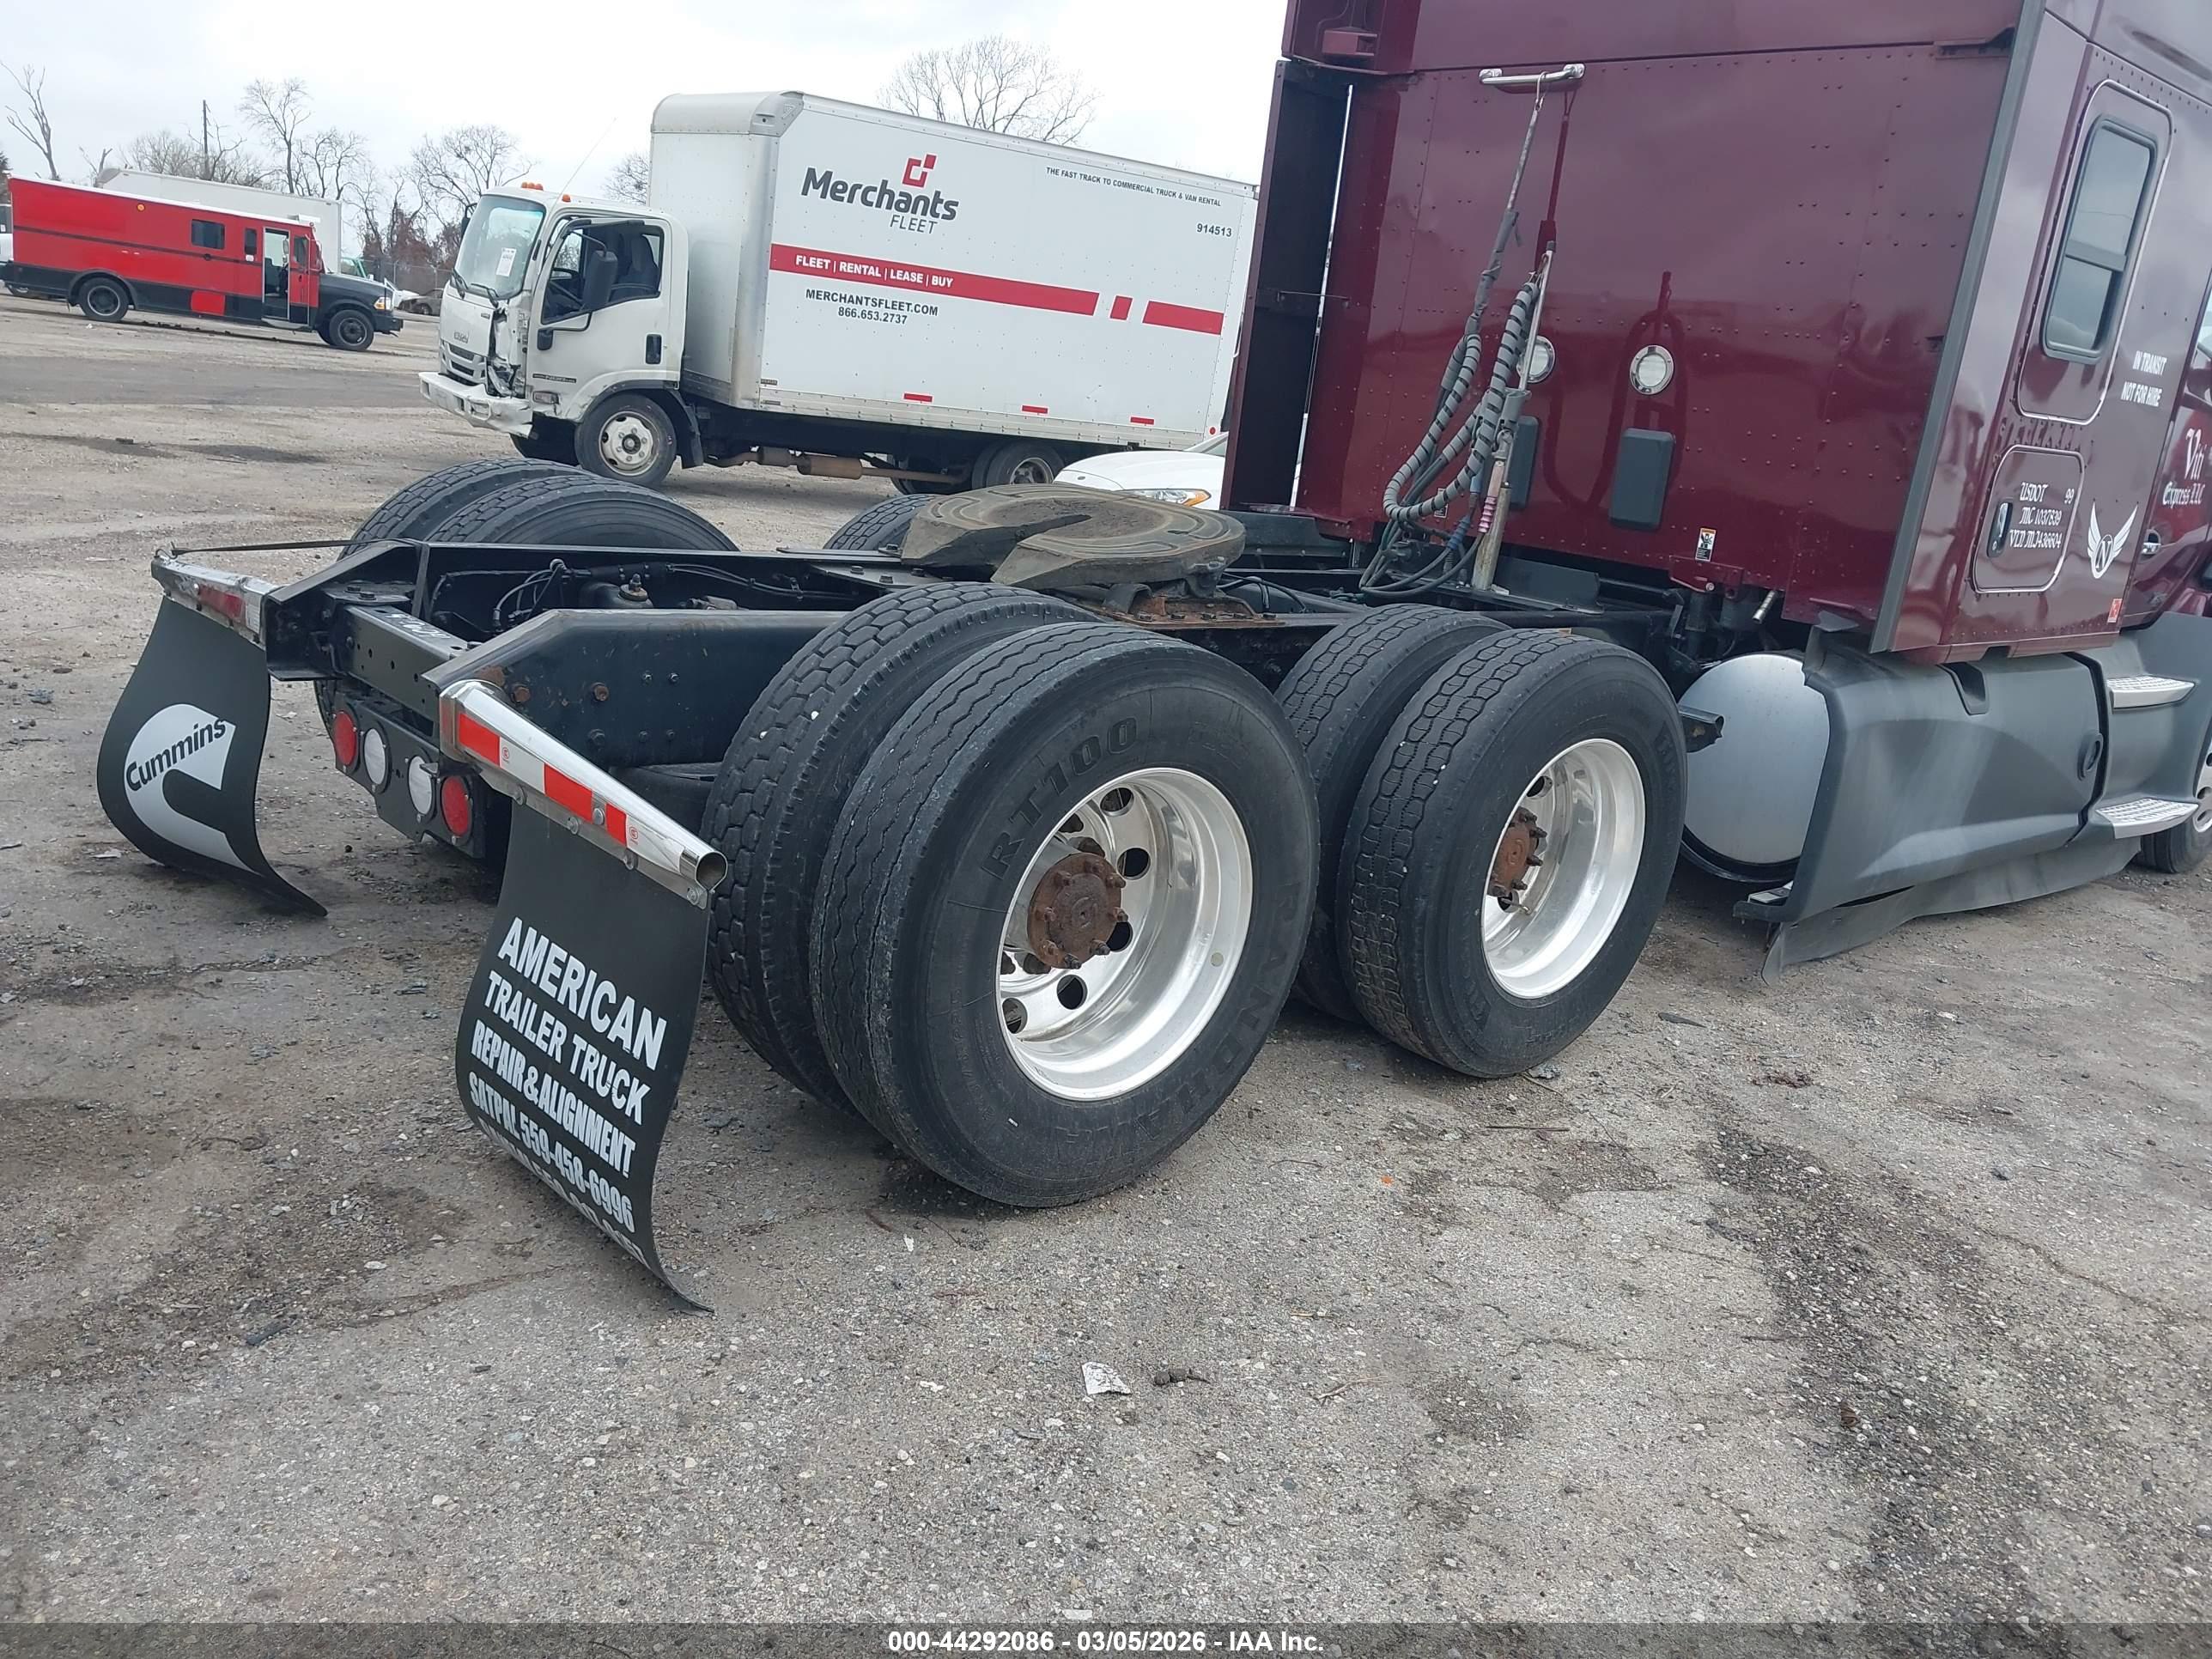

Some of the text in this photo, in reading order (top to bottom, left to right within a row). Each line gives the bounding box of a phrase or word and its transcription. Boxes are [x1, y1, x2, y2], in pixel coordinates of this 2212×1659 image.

[800, 167, 960, 221] Merchants
[1046, 167, 1060, 177] THE
[1060, 169, 1078, 179] FAST
[1079, 173, 1102, 184] TRACK
[1113, 179, 1155, 194] COMMERCIAL
[1156, 187, 1177, 198] TRUCK
[1184, 193, 1197, 203] VAN
[1198, 196, 1222, 207] RENTAL
[890, 214, 939, 234] FLEET
[1196, 222, 1233, 238] 914513
[795, 254, 831, 270] FLEET
[839, 261, 882, 277] RENTAL
[890, 268, 924, 284] LEASE
[931, 275, 954, 289] BUY
[805, 289, 939, 317] MERCHANTSFLEET.COM
[838, 307, 908, 325] 866.653.2737
[2132, 350, 2167, 375] IN TRANSIT
[2120, 381, 2136, 402] NOT
[2133, 384, 2148, 404] FOR
[2020, 482, 2049, 502] USDOT
[126, 718, 227, 791] Cummins
[497, 916, 667, 1071] AMERICAN
[484, 969, 652, 1126] TRAILER TRUCK
[468, 1071, 521, 1141] SATPAL
[519, 1111, 635, 1233] 559-458-6996
